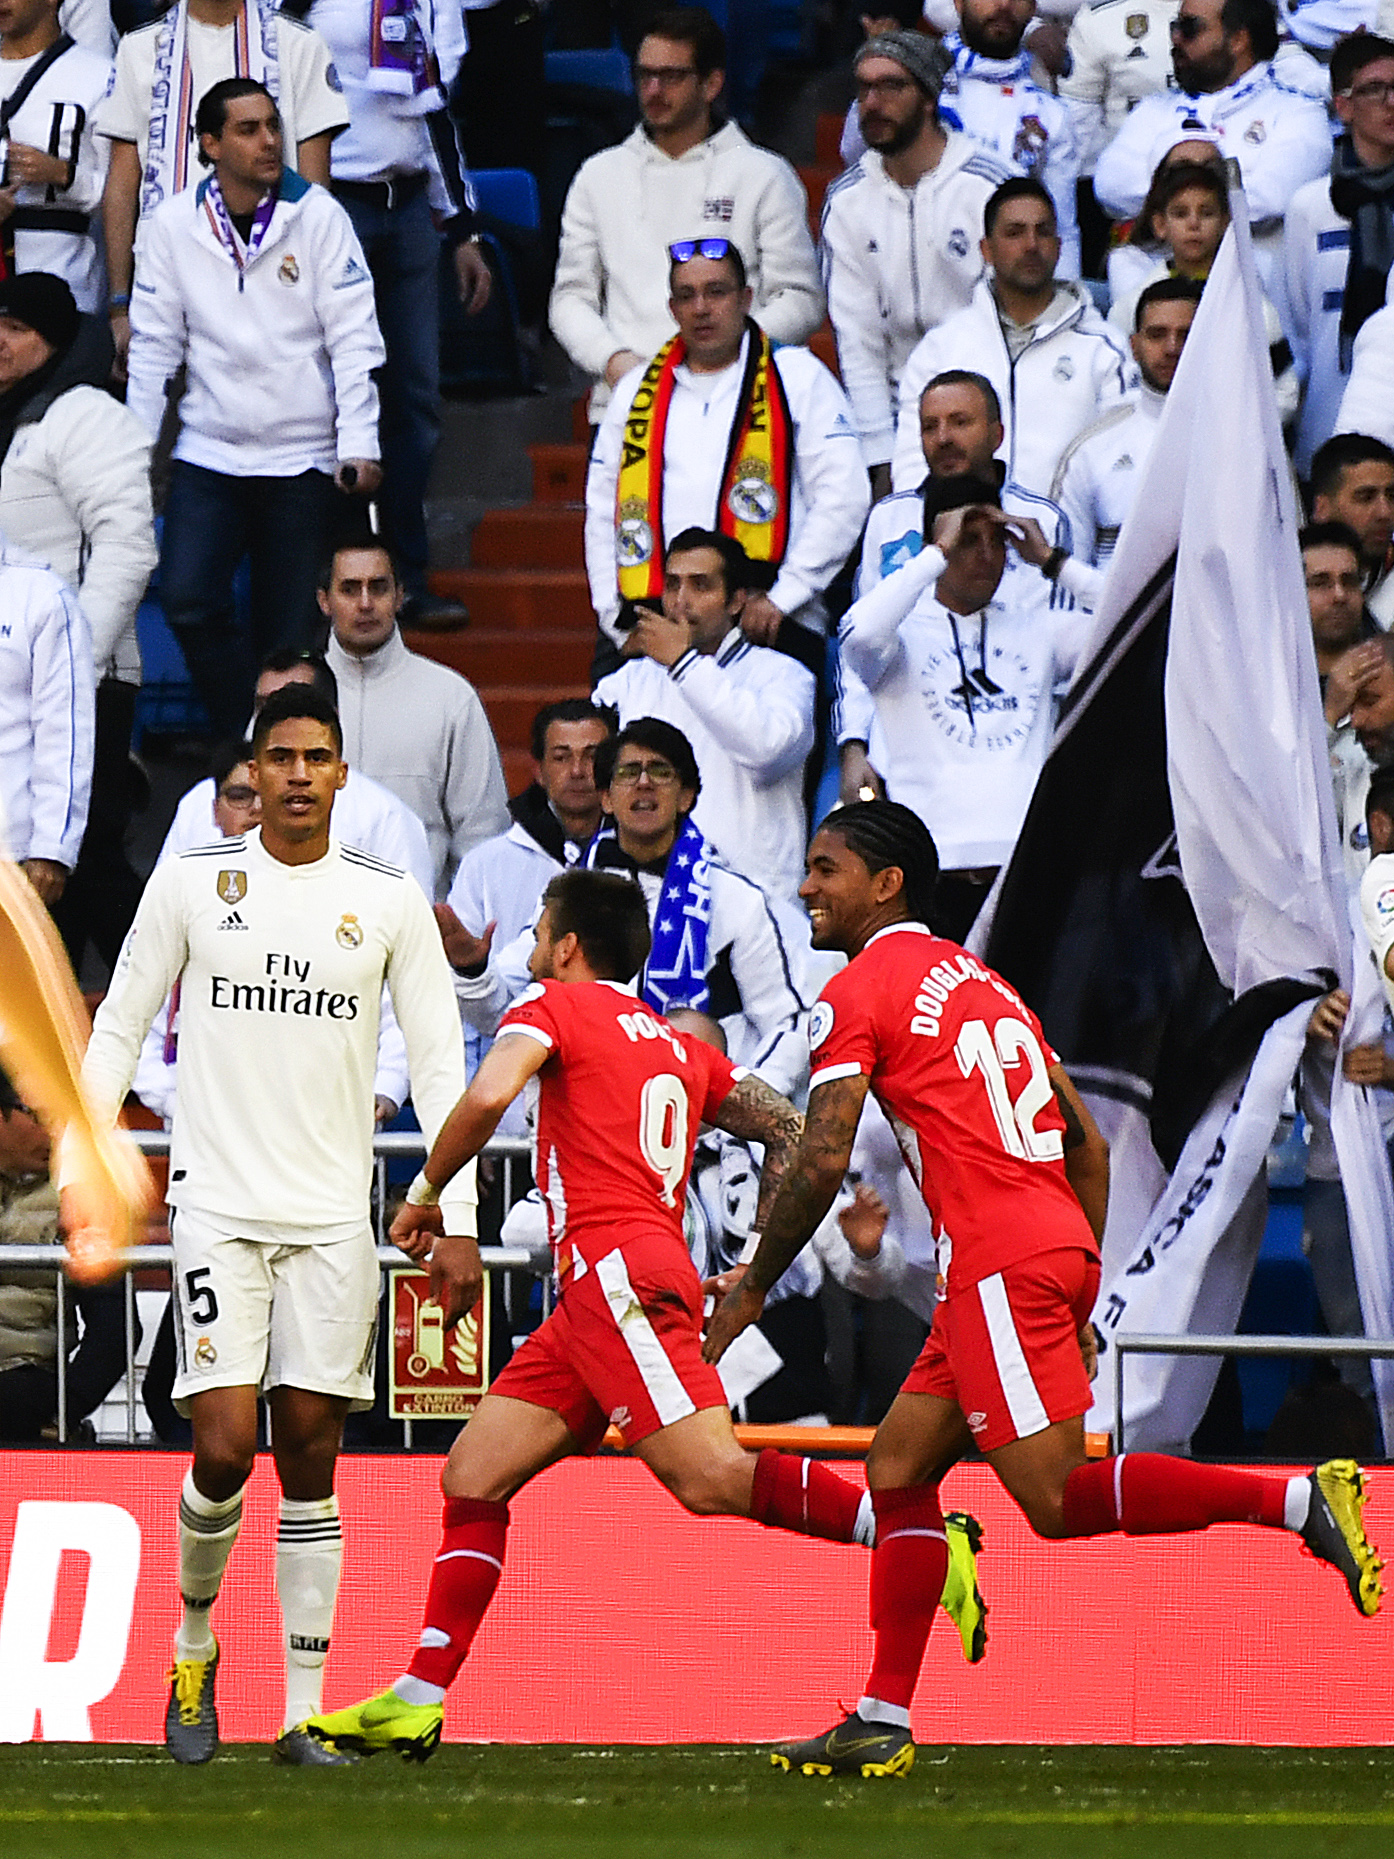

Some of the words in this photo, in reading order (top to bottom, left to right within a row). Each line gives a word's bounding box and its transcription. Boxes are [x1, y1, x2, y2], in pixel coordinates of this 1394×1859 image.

[266, 953, 311, 983] Fly
[211, 976, 360, 1021] Emirates
[953, 1017, 1065, 1163] 12
[639, 1073, 689, 1209] 9
[185, 1266, 219, 1325] 5
